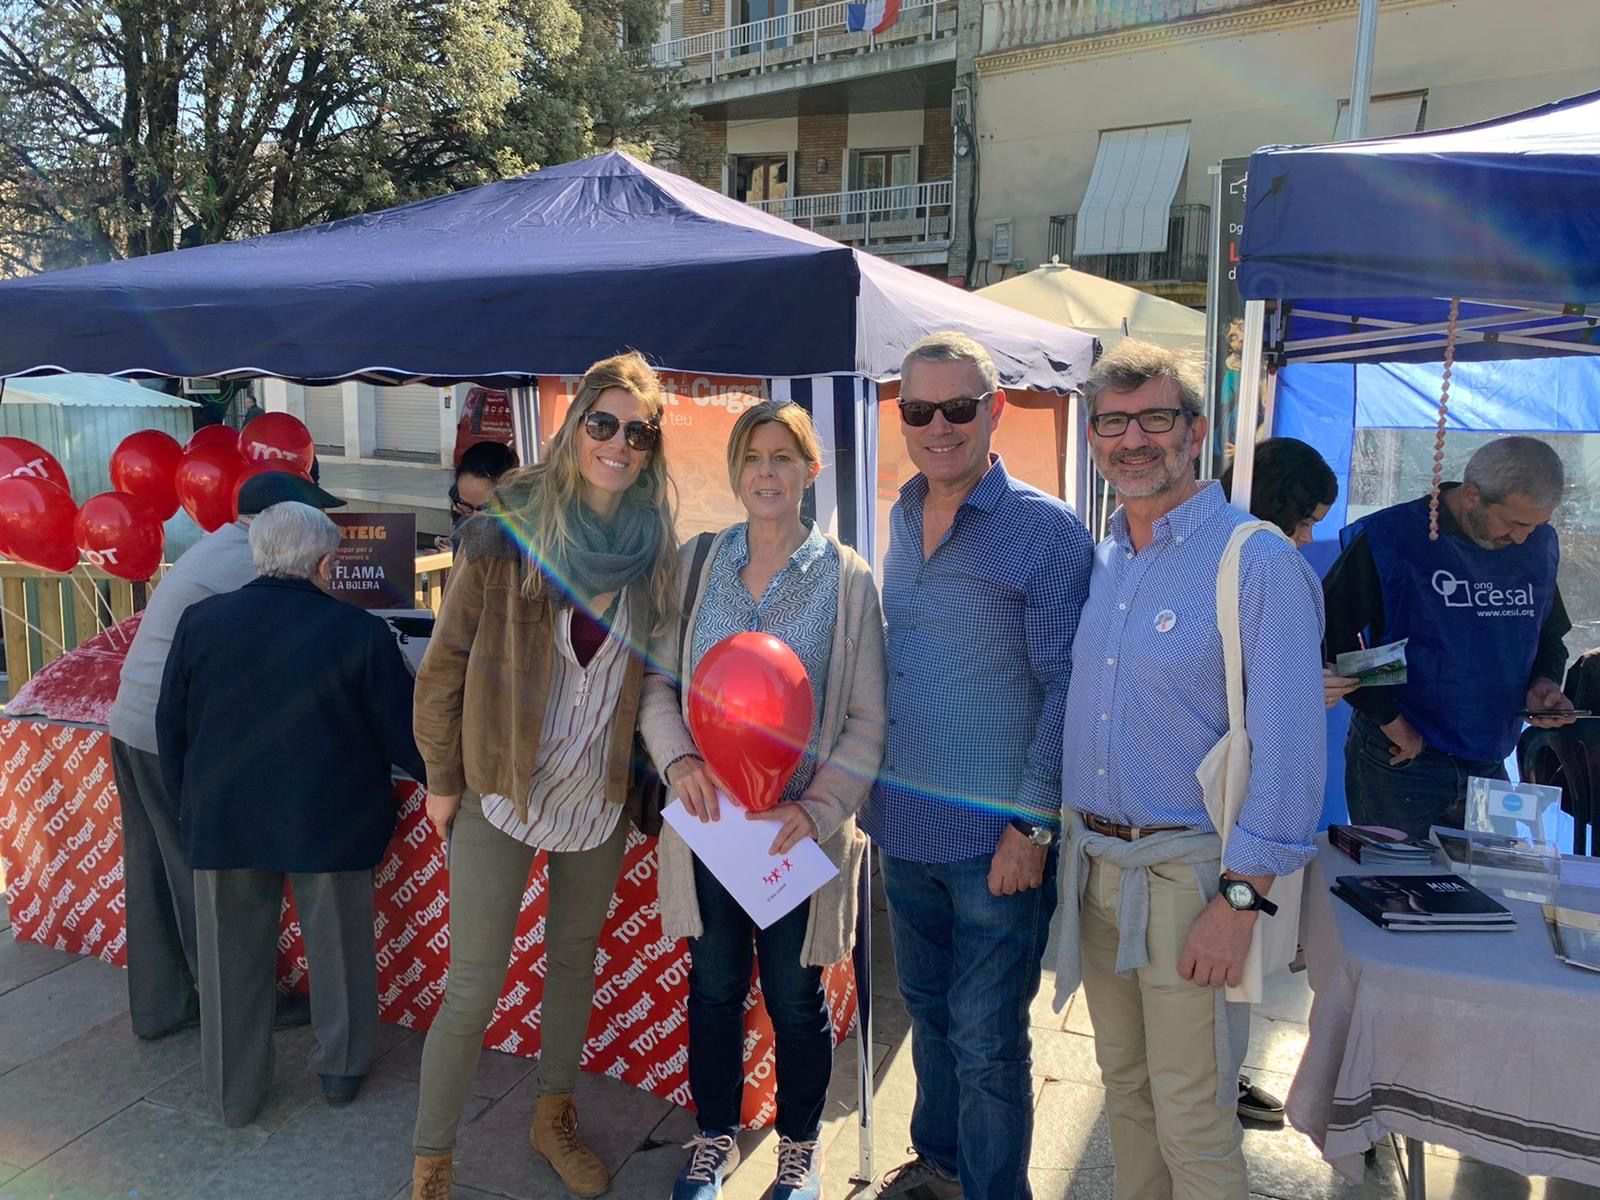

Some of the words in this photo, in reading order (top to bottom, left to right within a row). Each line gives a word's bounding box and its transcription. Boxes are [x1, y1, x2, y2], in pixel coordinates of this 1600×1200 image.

[671, 411, 693, 426] teu
[341, 526, 387, 540] RTEIG
[336, 566, 385, 579] FLAMA
[346, 581, 380, 590] BOLERA
[1473, 582, 1493, 591] ong
[1474, 583, 1534, 606] cesal
[4, 740, 30, 774] Cugat
[14, 769, 36, 798] TOT
[31, 748, 56, 777] Sant
[63, 746, 83, 775] TOT
[33, 778, 64, 813] Cugat
[43, 807, 70, 837] TOT
[64, 787, 87, 815] Sant
[82, 756, 109, 790] Cugat
[93, 786, 113, 815] TOT
[46, 847, 70, 877] Sant
[66, 816, 96, 850] Cugat
[404, 816, 434, 850] TOT
[76, 845, 102, 875] TOT
[97, 826, 119, 854] Sant
[390, 876, 418, 909] TOT
[413, 852, 443, 886] Sant
[624, 850, 659, 887] TOT
[18, 892, 42, 923] Cugat
[31, 915, 50, 944] TOT
[52, 877, 76, 910] Cugat
[62, 907, 80, 933] TOT
[74, 886, 101, 916] Sant
[389, 923, 418, 955] Sant
[415, 889, 450, 926] Cugat
[612, 911, 648, 945] TOT
[396, 956, 427, 987] Cugat
[614, 957, 648, 991] Sant
[655, 958, 688, 993] TOT
[413, 985, 437, 1011] TOT
[497, 980, 530, 1013] Cugat
[588, 1022, 620, 1052] Sant
[615, 991, 655, 1030] Cugat
[629, 1026, 660, 1057] TOT
[655, 1006, 686, 1040] Sant
